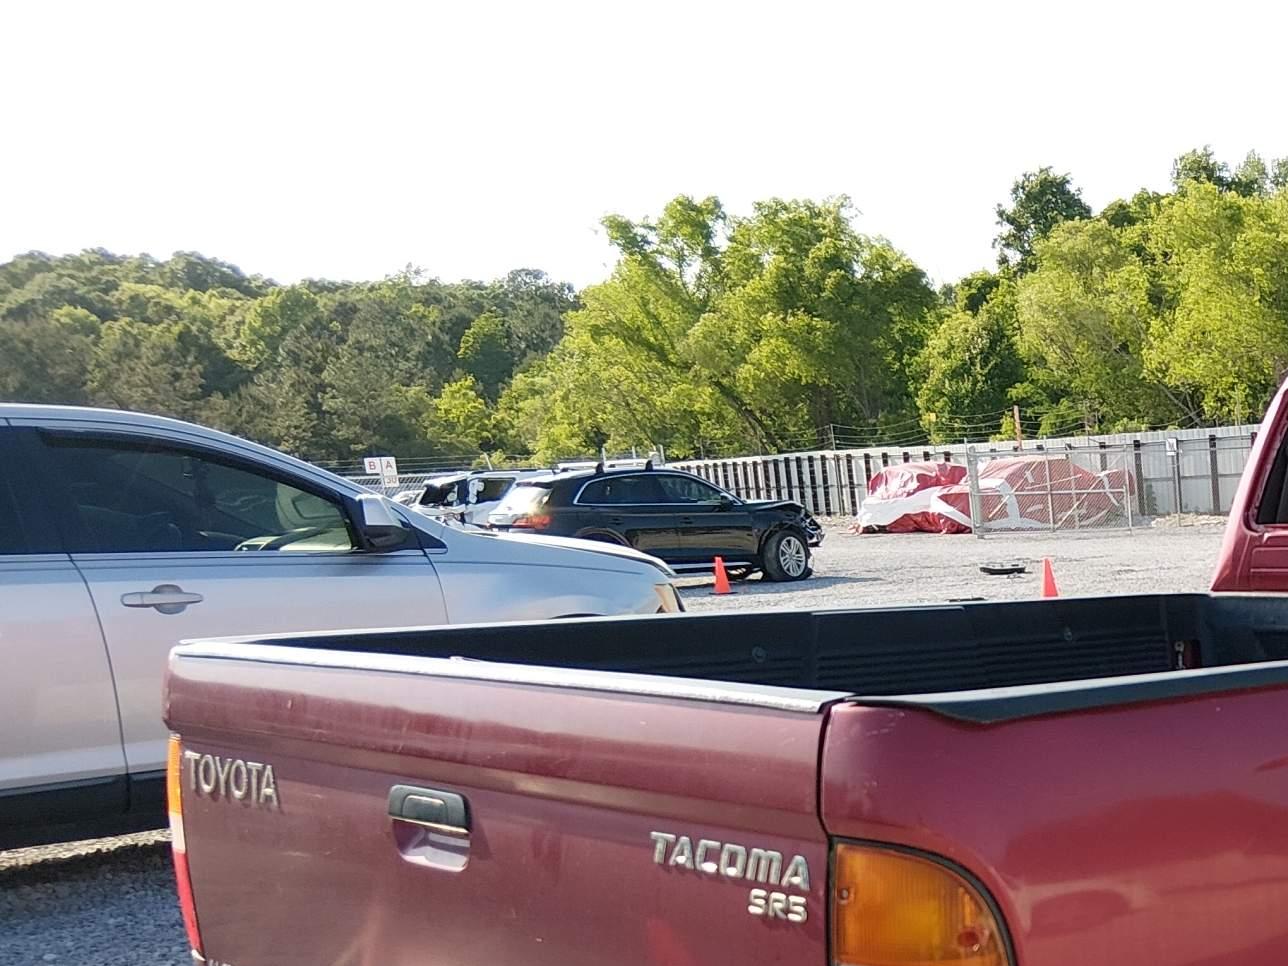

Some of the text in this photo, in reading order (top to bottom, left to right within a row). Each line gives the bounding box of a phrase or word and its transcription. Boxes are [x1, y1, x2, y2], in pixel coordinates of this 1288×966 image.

[368, 461, 377, 470] B
[385, 460, 394, 469] A
[184, 750, 278, 810] TOYOTA
[650, 831, 810, 891] TACOMA
[748, 888, 808, 923] SR5
